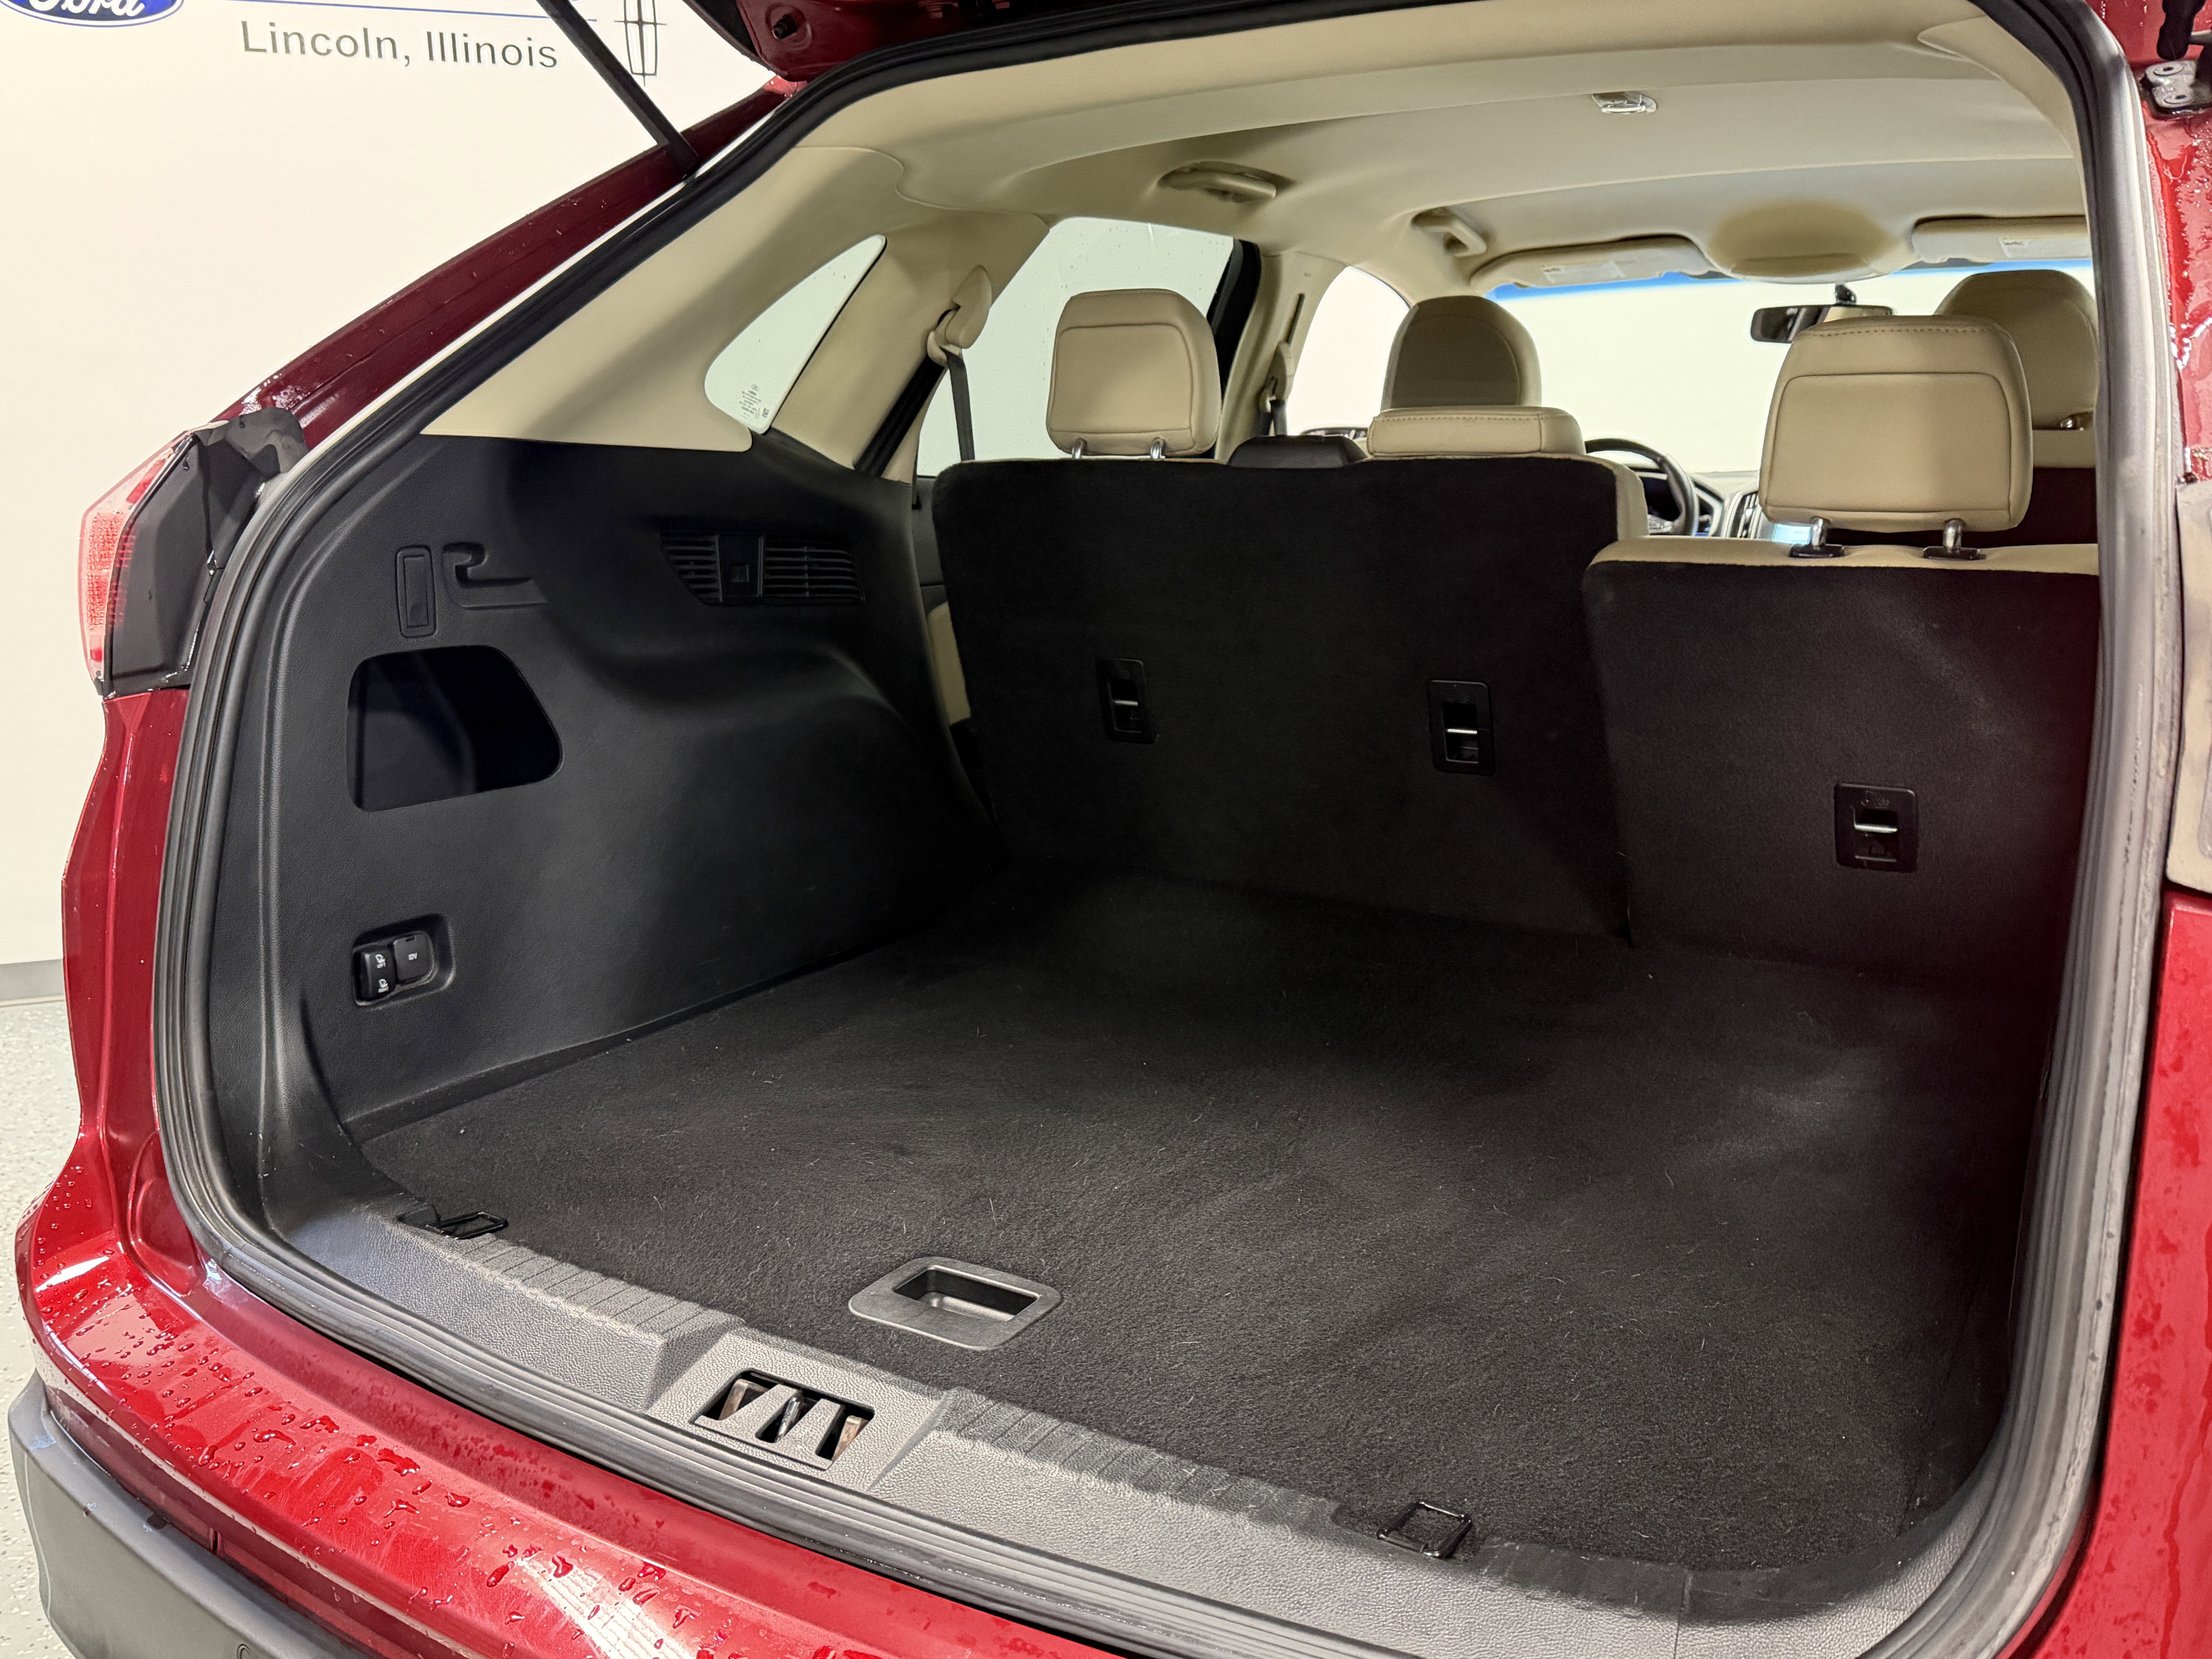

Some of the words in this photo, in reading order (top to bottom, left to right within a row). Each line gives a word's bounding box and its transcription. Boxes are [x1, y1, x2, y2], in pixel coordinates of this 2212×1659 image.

[29, 0, 145, 17] ord
[241, 21, 410, 67] Lincoln,
[426, 31, 557, 68] Illinois
